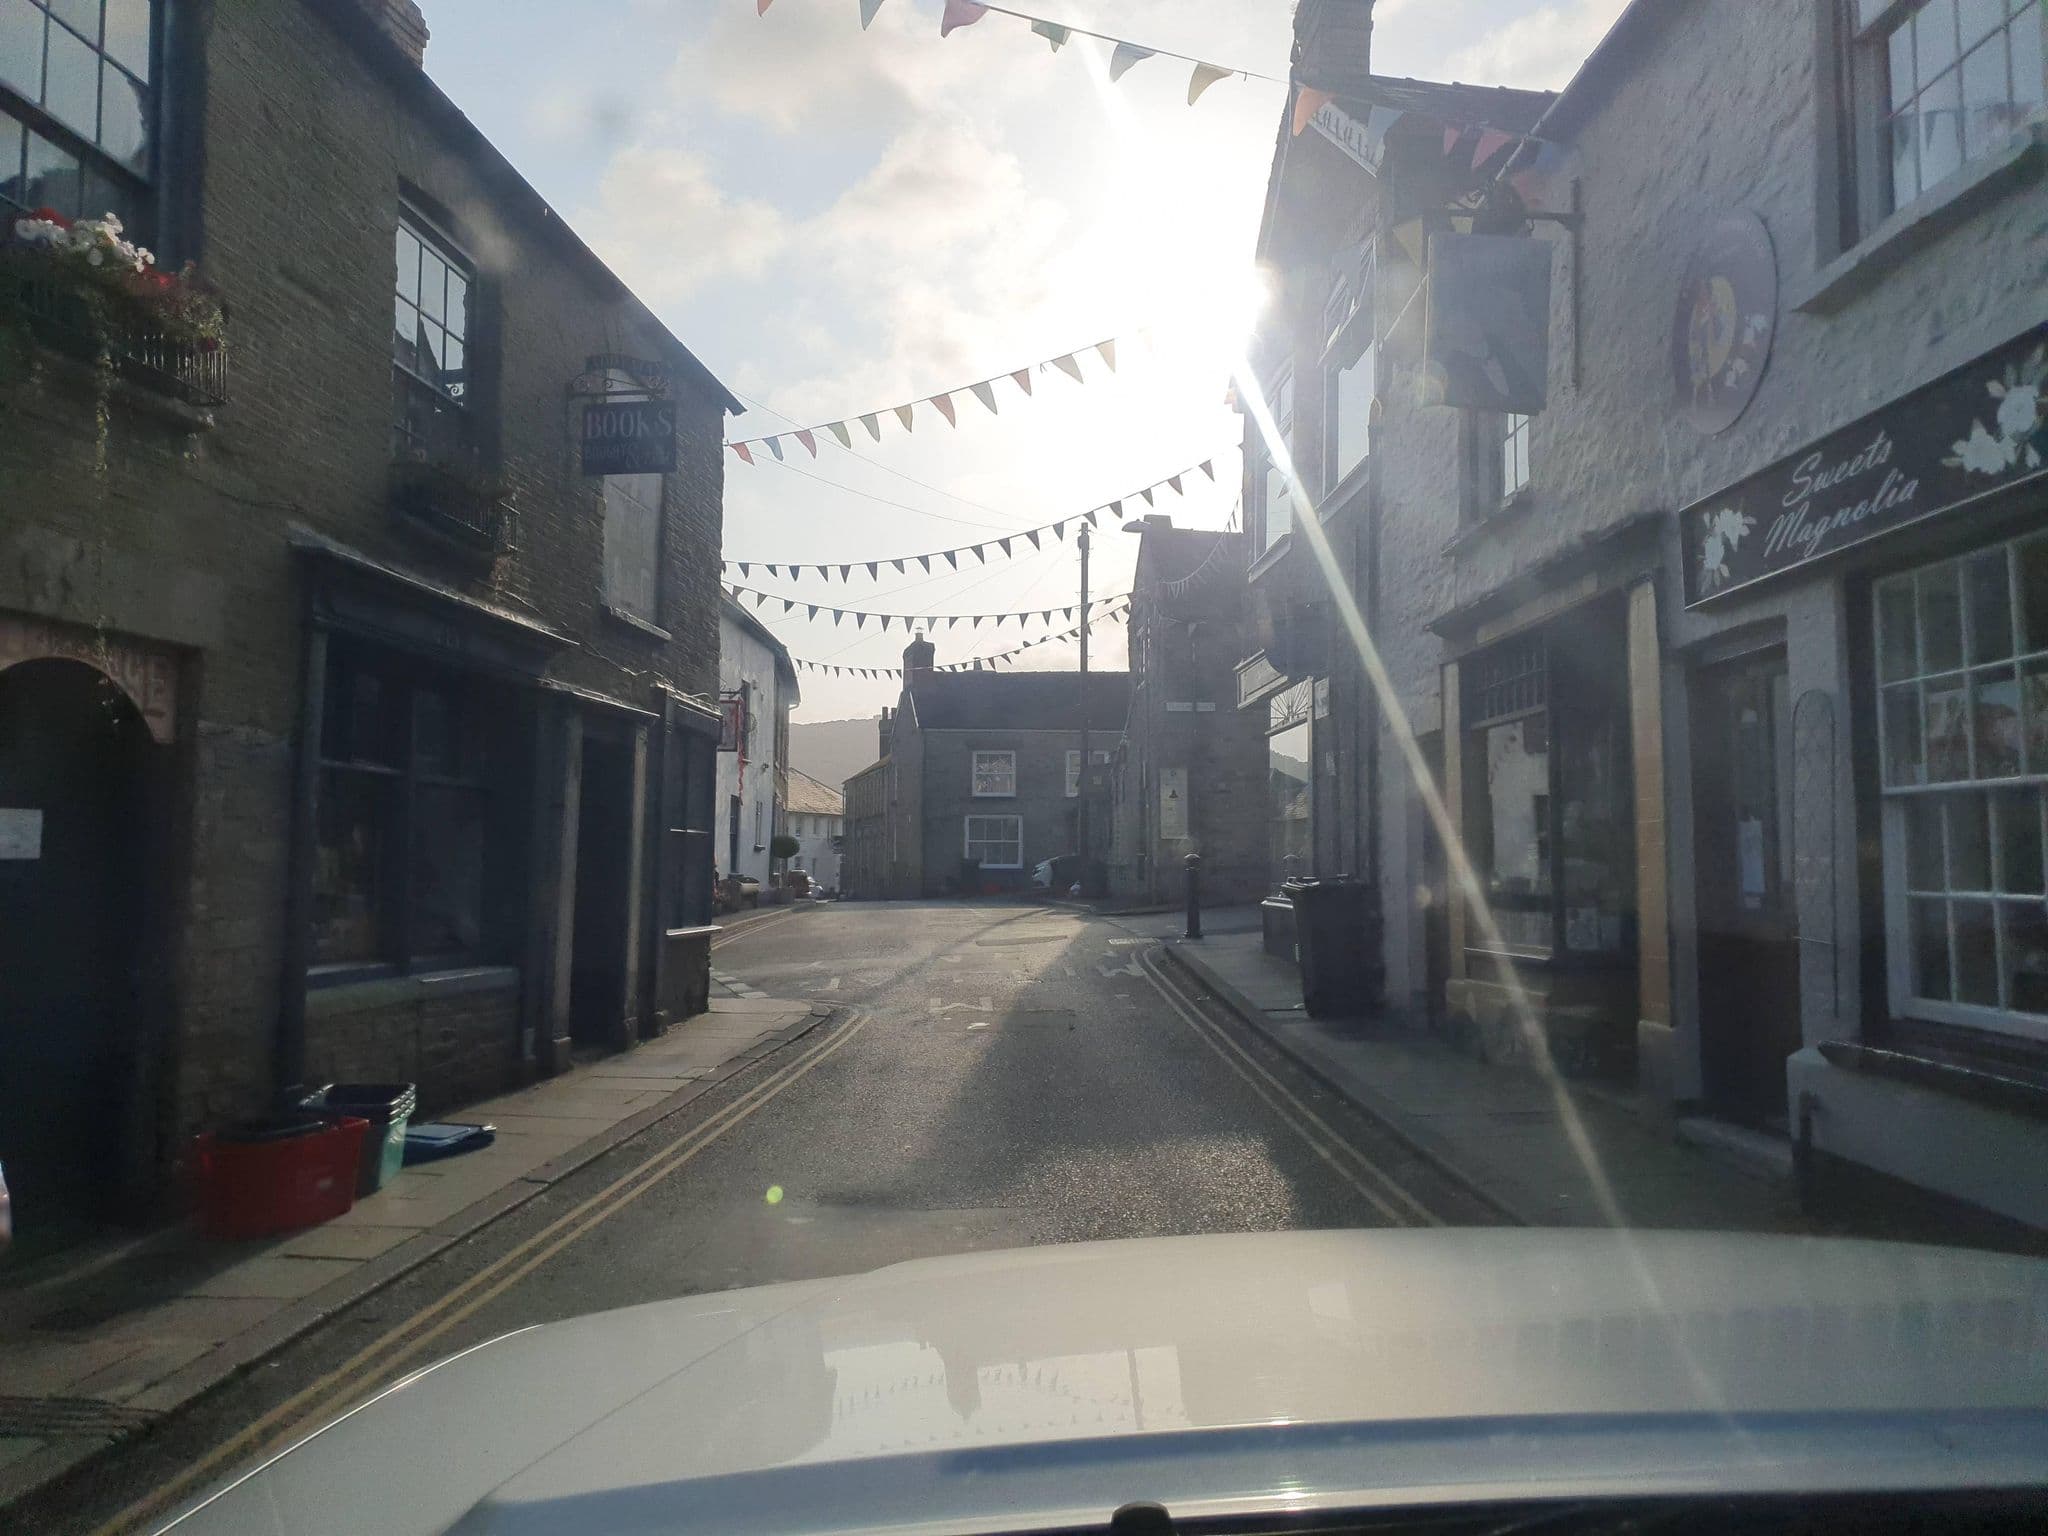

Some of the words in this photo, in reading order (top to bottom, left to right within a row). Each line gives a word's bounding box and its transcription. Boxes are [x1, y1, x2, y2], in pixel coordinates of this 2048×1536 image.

[587, 408, 672, 439] BOOKS
[1782, 430, 1893, 507] Sweets
[1764, 468, 1920, 558] Magnolia
